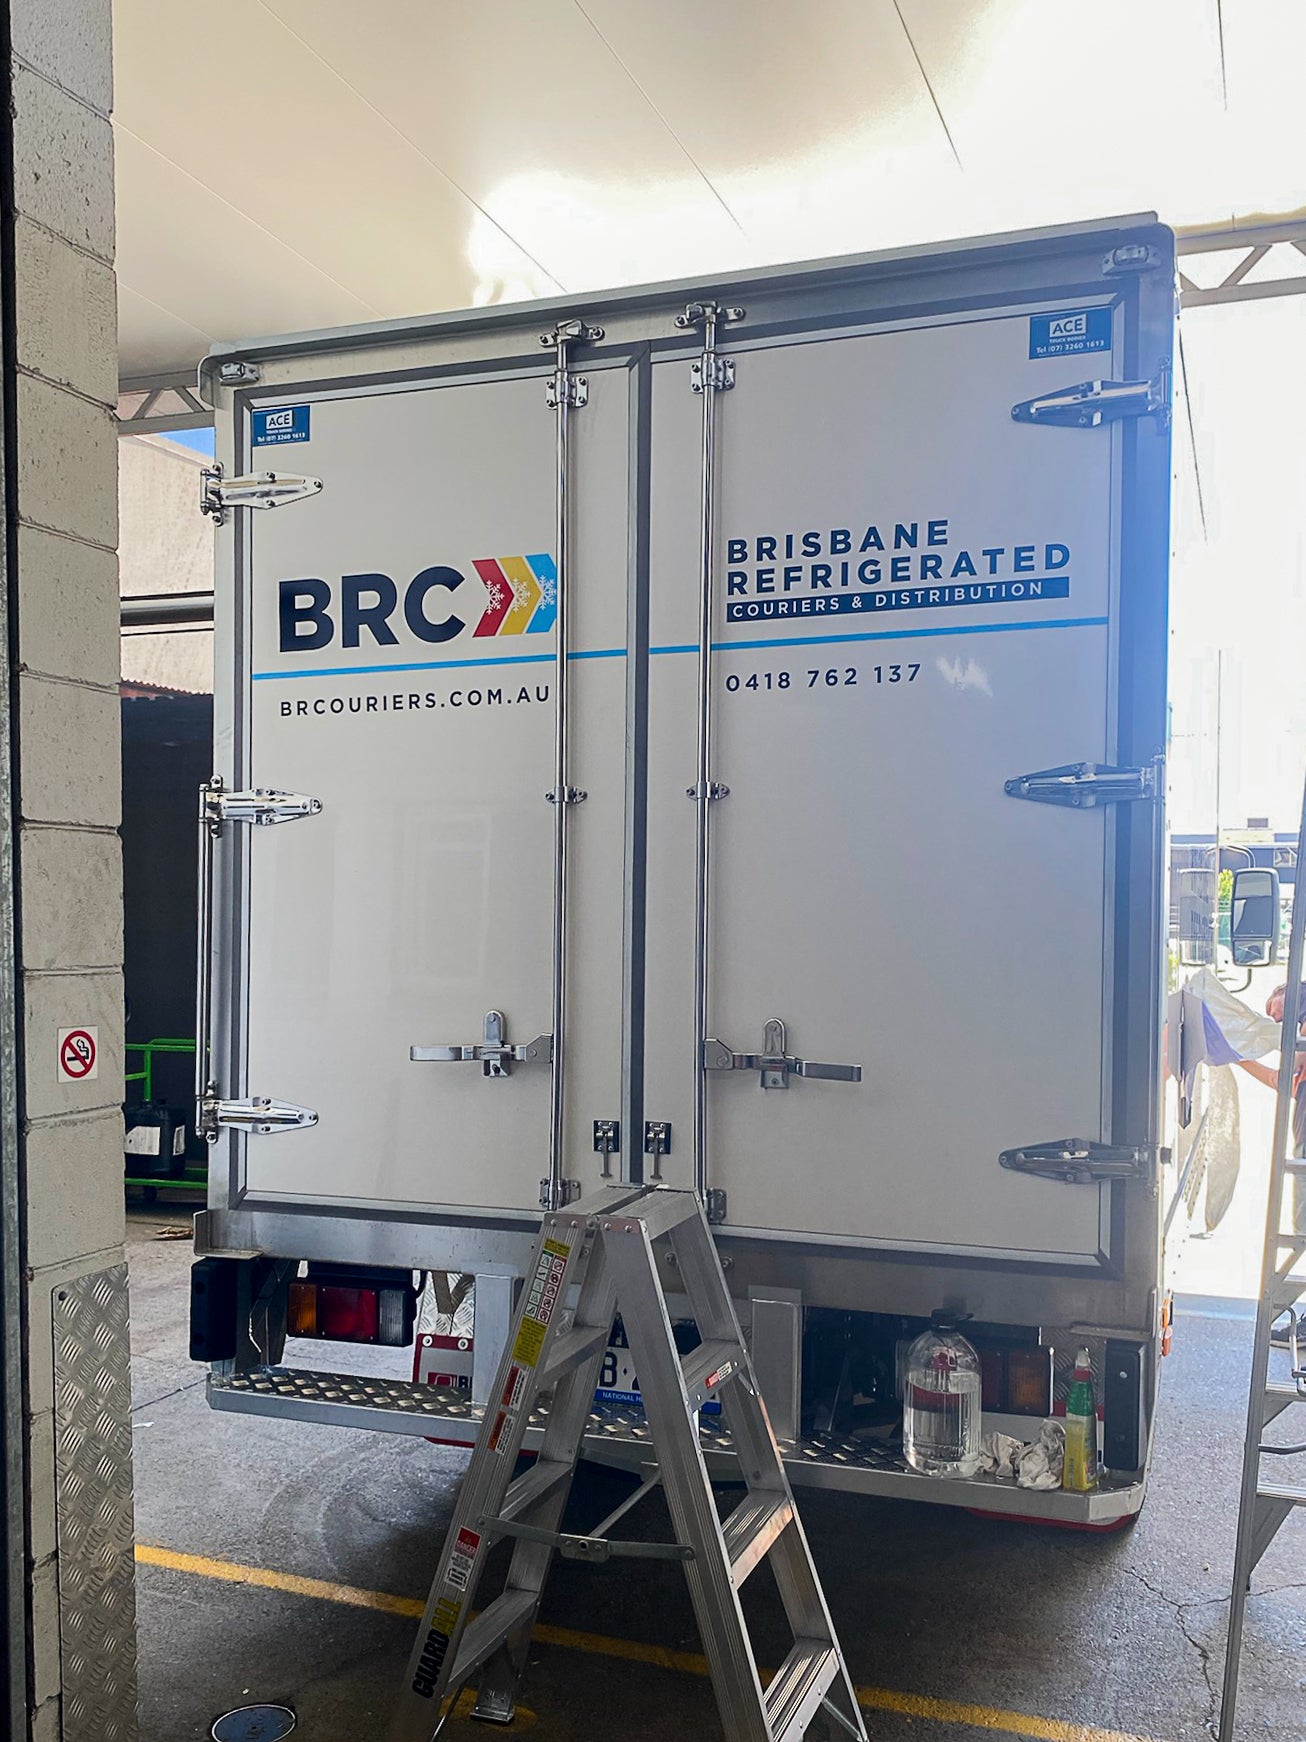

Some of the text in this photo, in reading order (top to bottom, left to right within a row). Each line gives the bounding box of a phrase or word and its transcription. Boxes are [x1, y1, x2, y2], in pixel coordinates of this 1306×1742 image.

[1052, 318, 1083, 335] ACE
[1065, 343, 1084, 351] 3260
[1086, 340, 1104, 348] 1613
[268, 413, 290, 427] ACE
[727, 520, 949, 564] BRISBANE
[727, 543, 1070, 596] REFRIGERATED
[278, 565, 466, 653] BRC
[732, 581, 1042, 618] COURIERS & DISTRIBUTION
[726, 662, 922, 692] 0418 762 137
[280, 685, 550, 717] BRCOURIERS.COM.AU
[602, 1391, 634, 1402] NATIONAL
